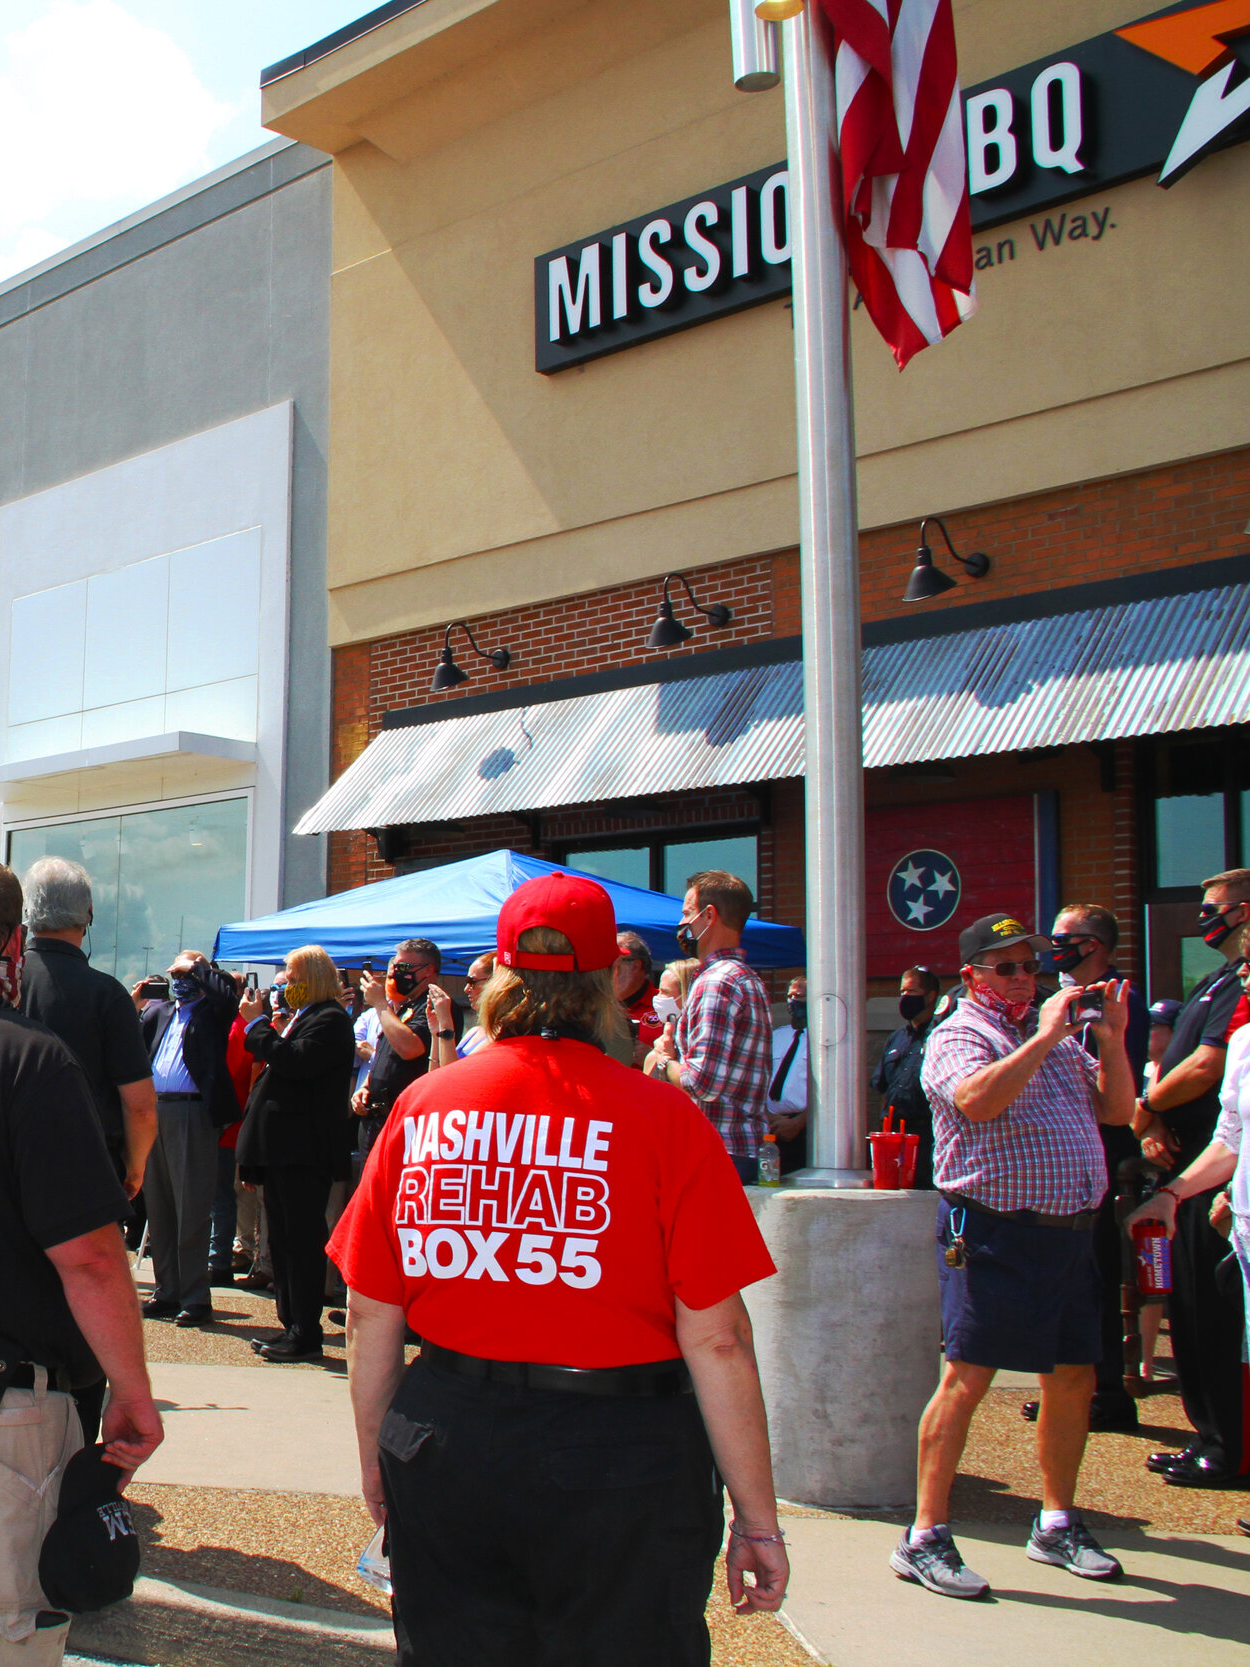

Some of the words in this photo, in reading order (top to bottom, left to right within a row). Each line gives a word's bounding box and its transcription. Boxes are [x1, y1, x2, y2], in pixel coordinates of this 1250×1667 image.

[549, 170, 792, 342] MISSIO
[966, 61, 1086, 196] BQ
[1030, 206, 1117, 252] Way.
[402, 1109, 614, 1172] NASHVILLE
[395, 1163, 612, 1235] REHAB
[397, 1227, 511, 1283] BOX
[514, 1232, 602, 1290] 55
[1151, 1236, 1164, 1289] HOMETOWN
